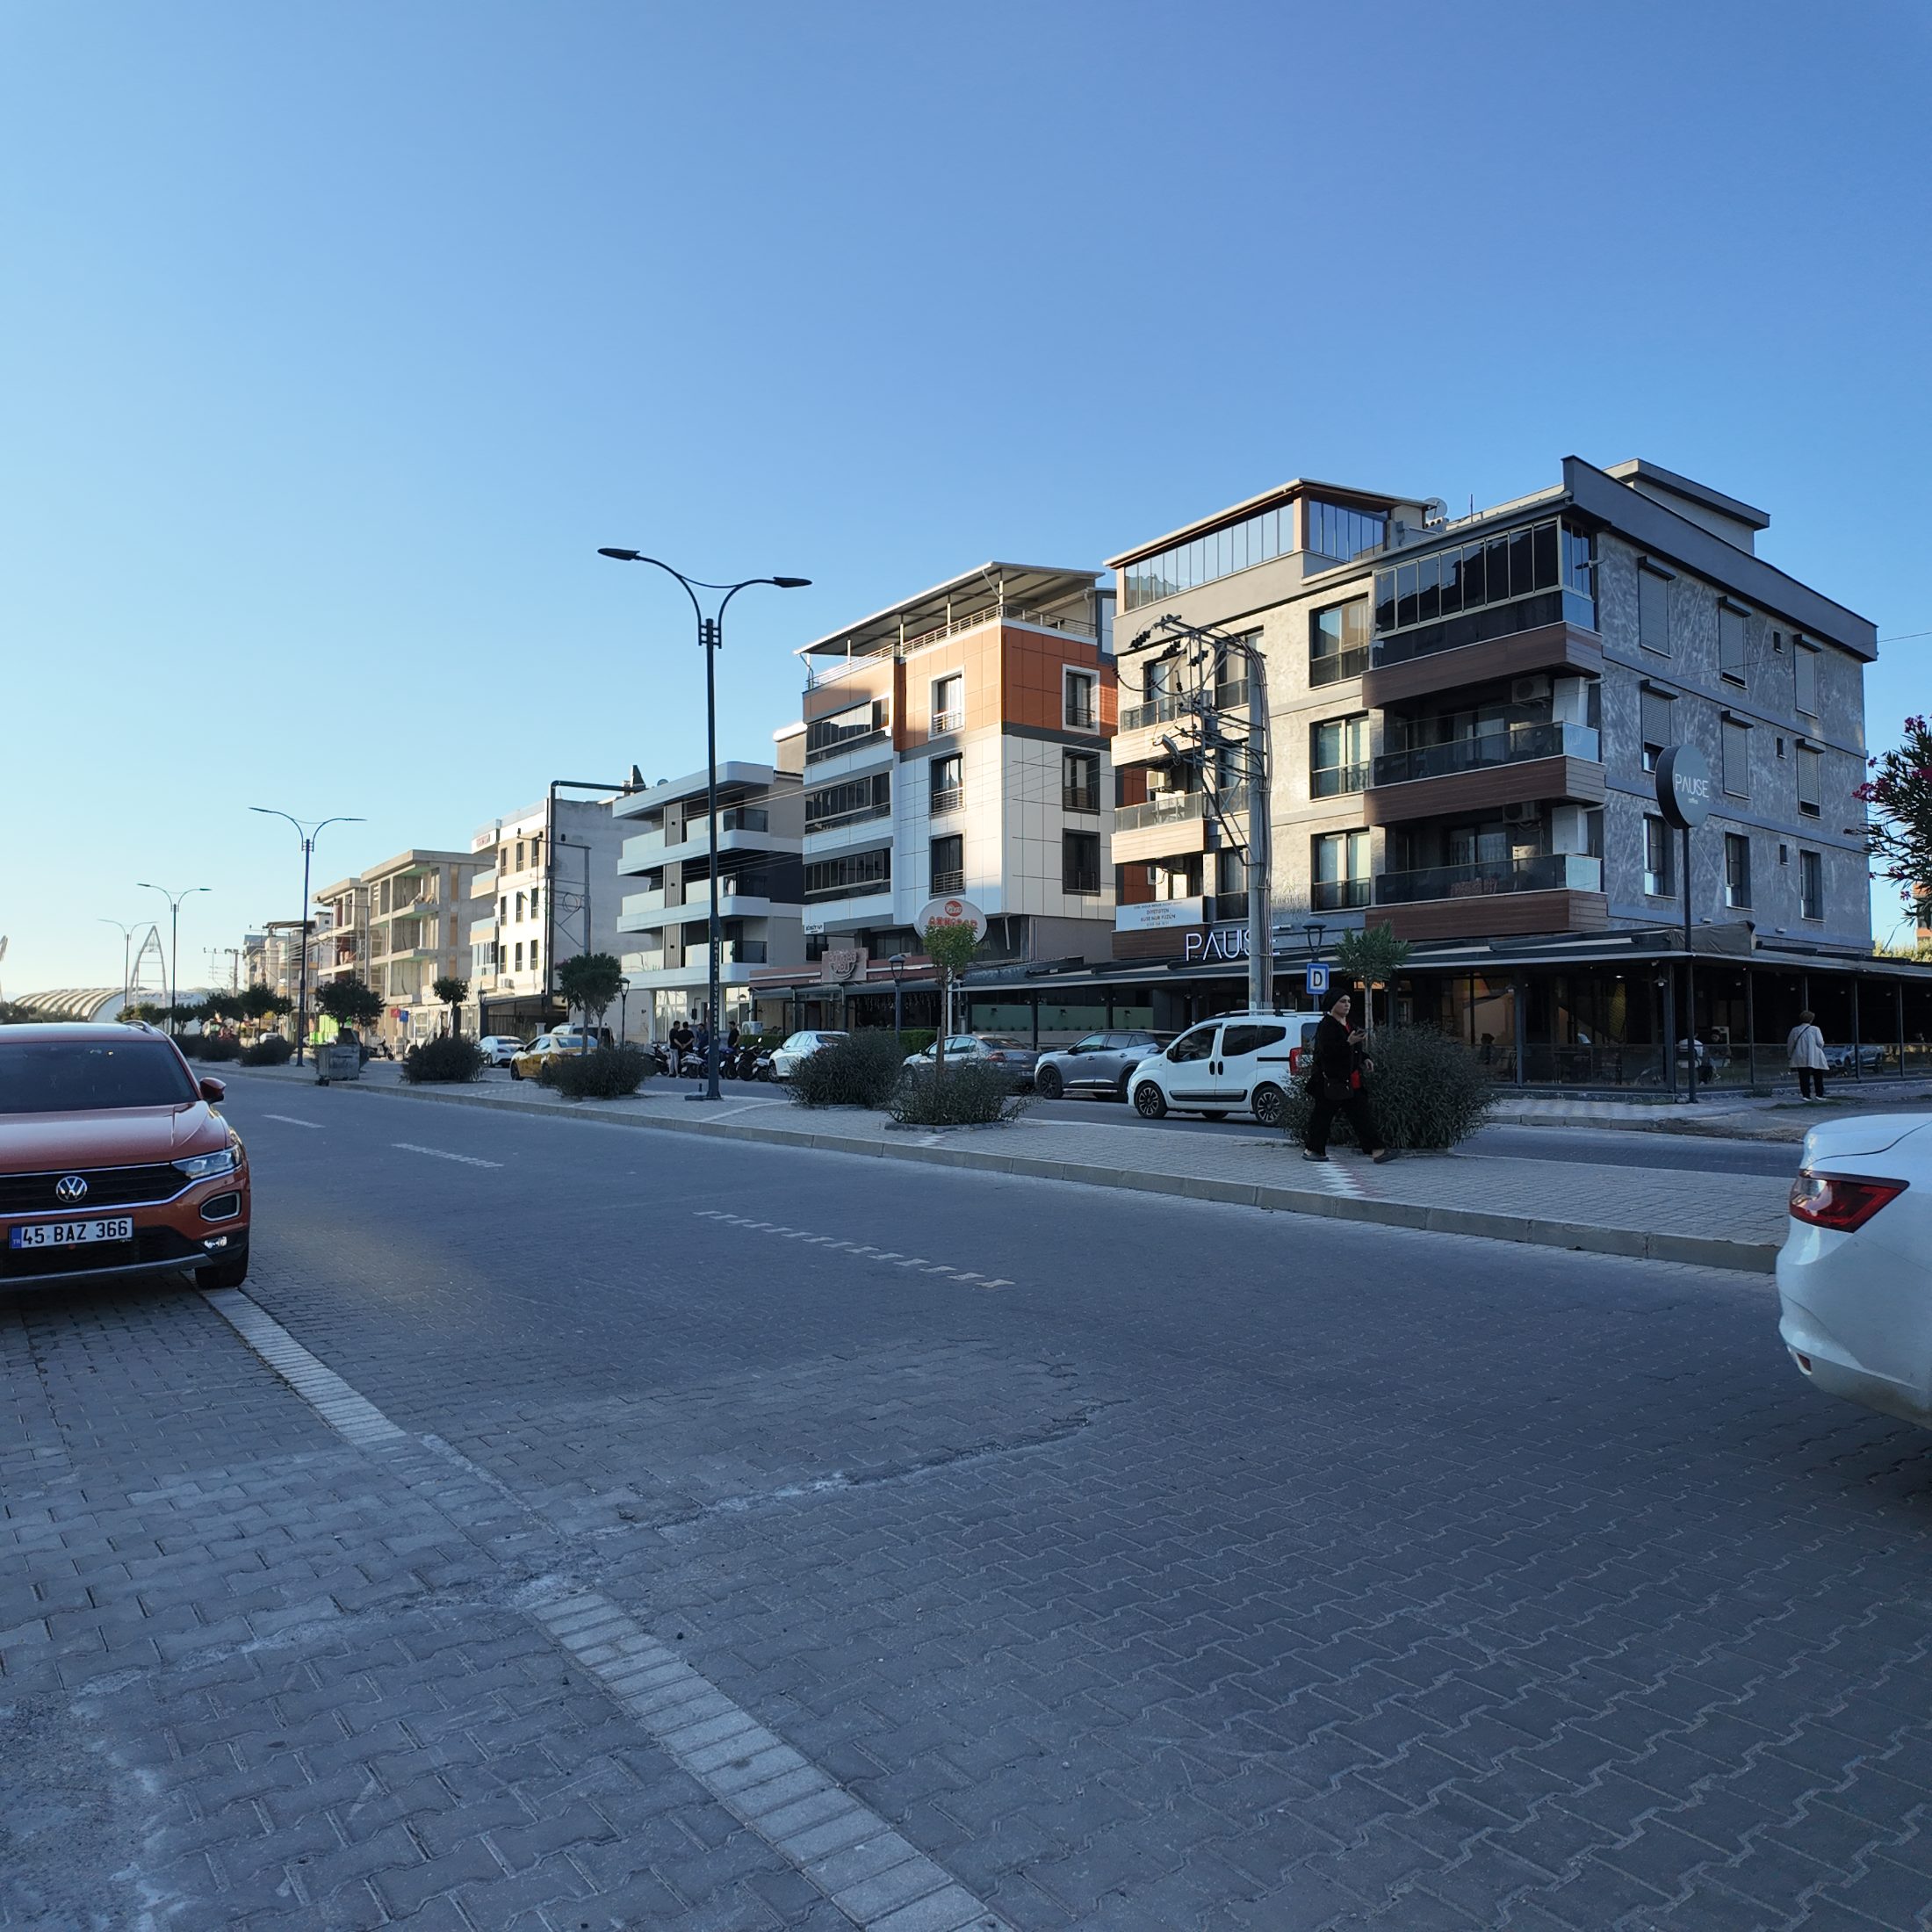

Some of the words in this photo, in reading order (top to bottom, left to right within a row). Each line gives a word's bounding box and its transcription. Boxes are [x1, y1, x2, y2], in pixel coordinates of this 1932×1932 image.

[1675, 774, 1709, 798] PAUSE
[1313, 970, 1323, 987] D
[23, 1228, 45, 1245] 45
[54, 1223, 87, 1243] BAZ
[96, 1220, 128, 1239] 366
